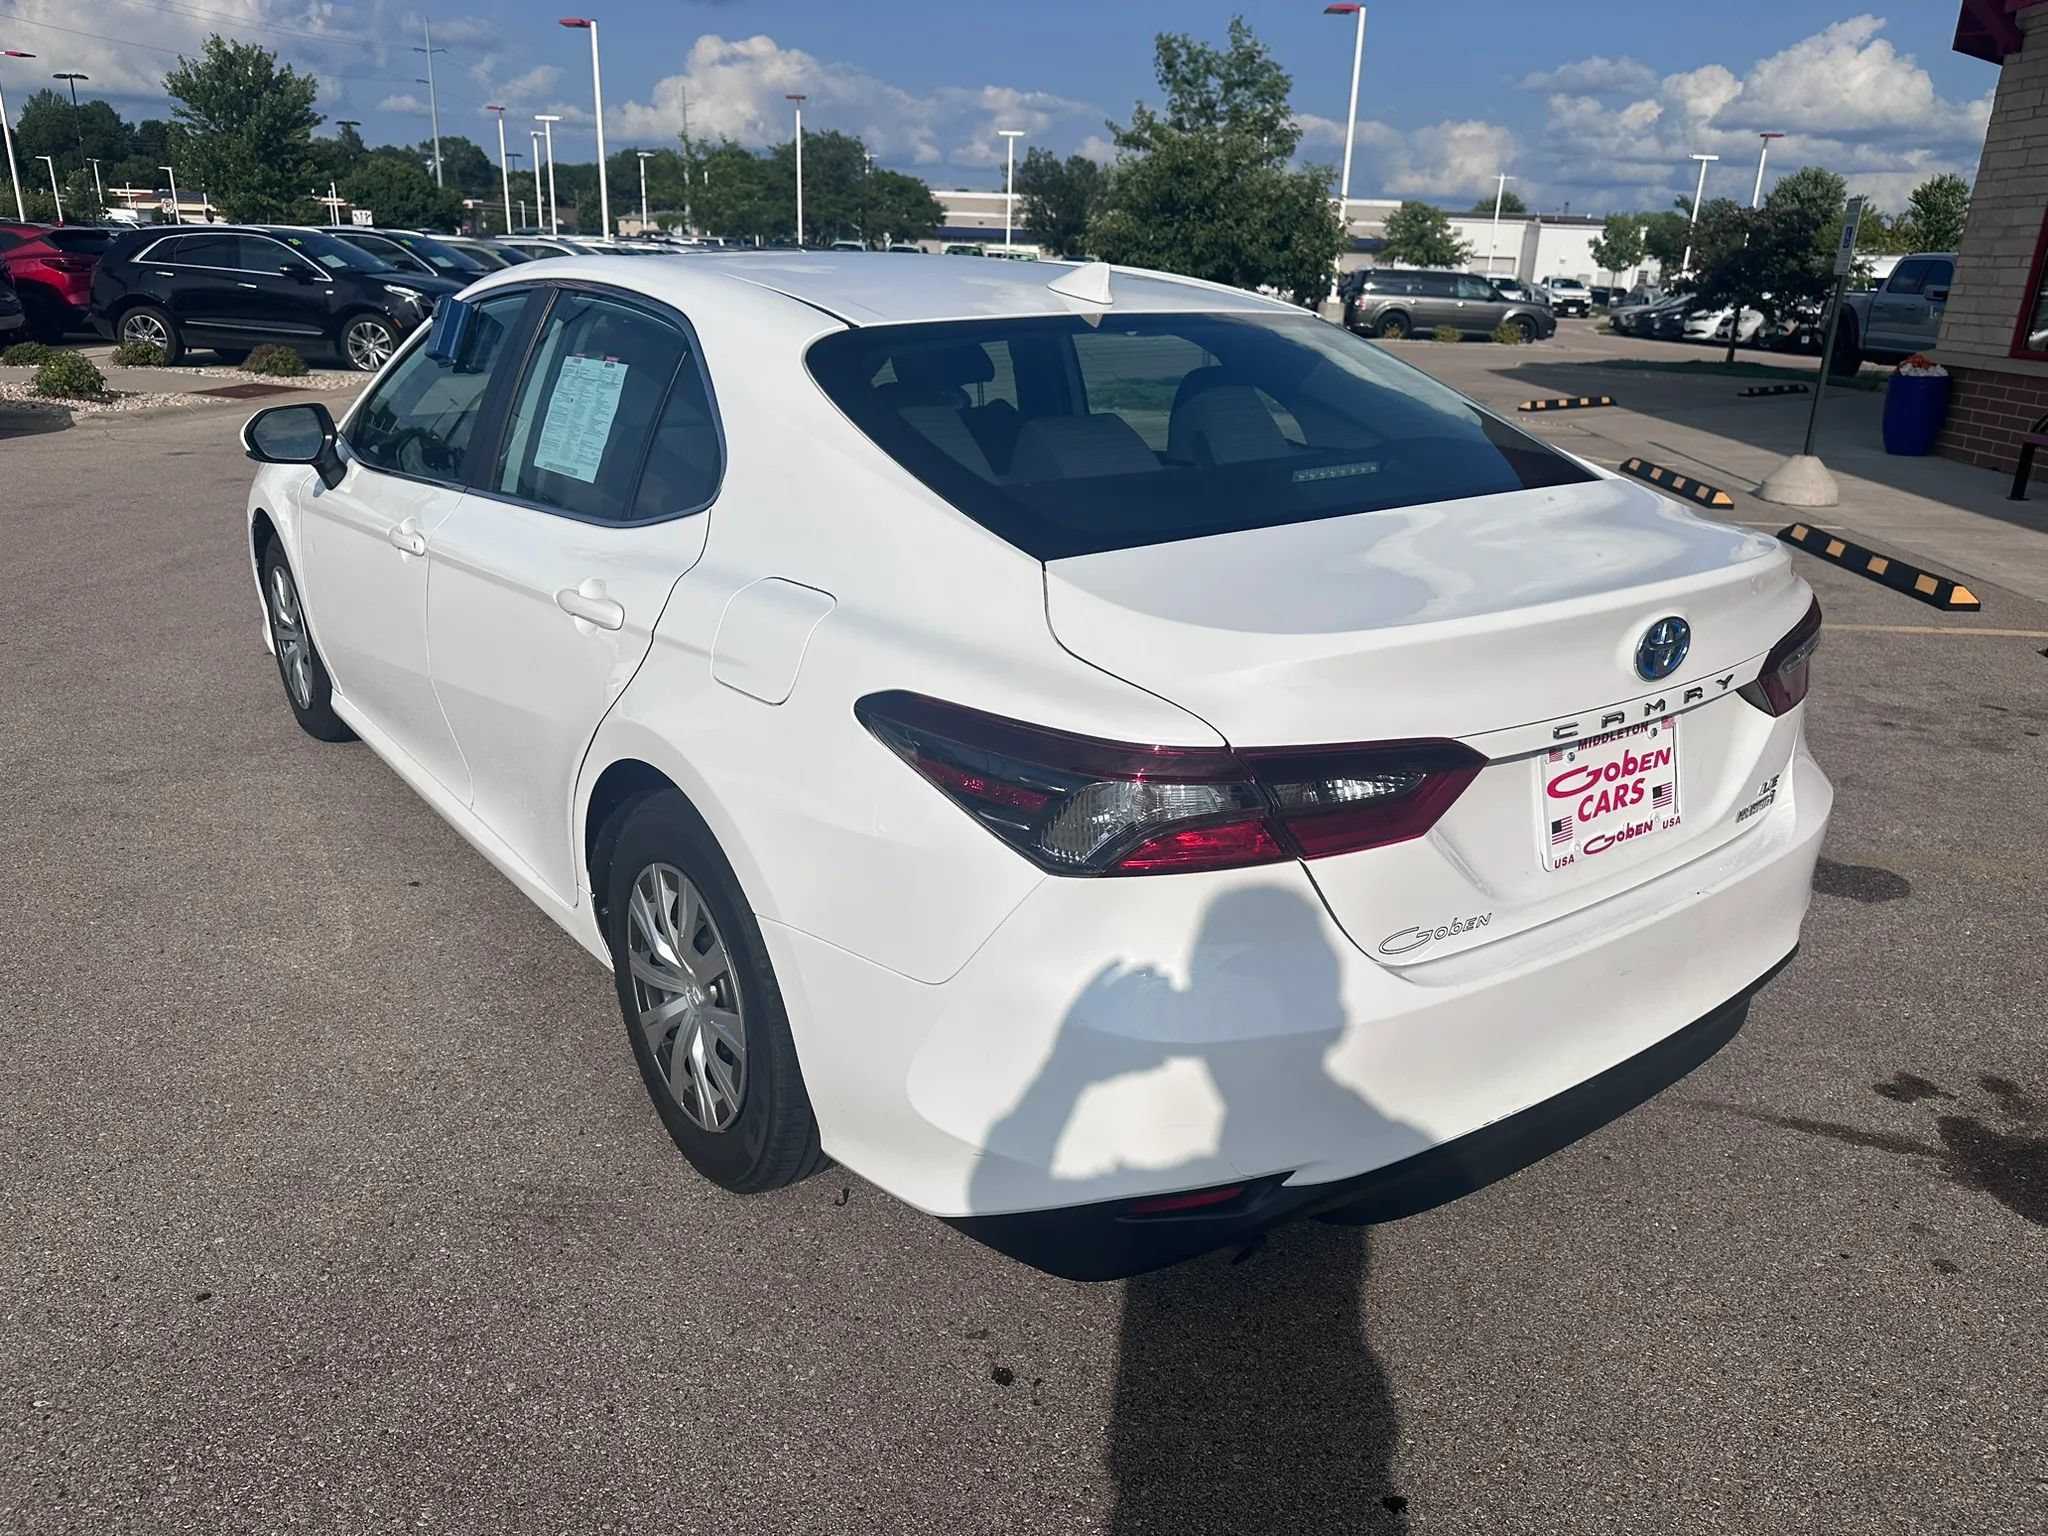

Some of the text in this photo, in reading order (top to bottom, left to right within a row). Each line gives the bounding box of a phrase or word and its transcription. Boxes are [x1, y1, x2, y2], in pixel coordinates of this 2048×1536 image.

[1553, 674, 1734, 739] CAMRY
[1577, 721, 1650, 751] MIDDLETON
[1758, 774, 1779, 797] LE
[1577, 778, 1646, 823] CARS
[1661, 816, 1681, 830] USA
[1554, 854, 1575, 869] USA
